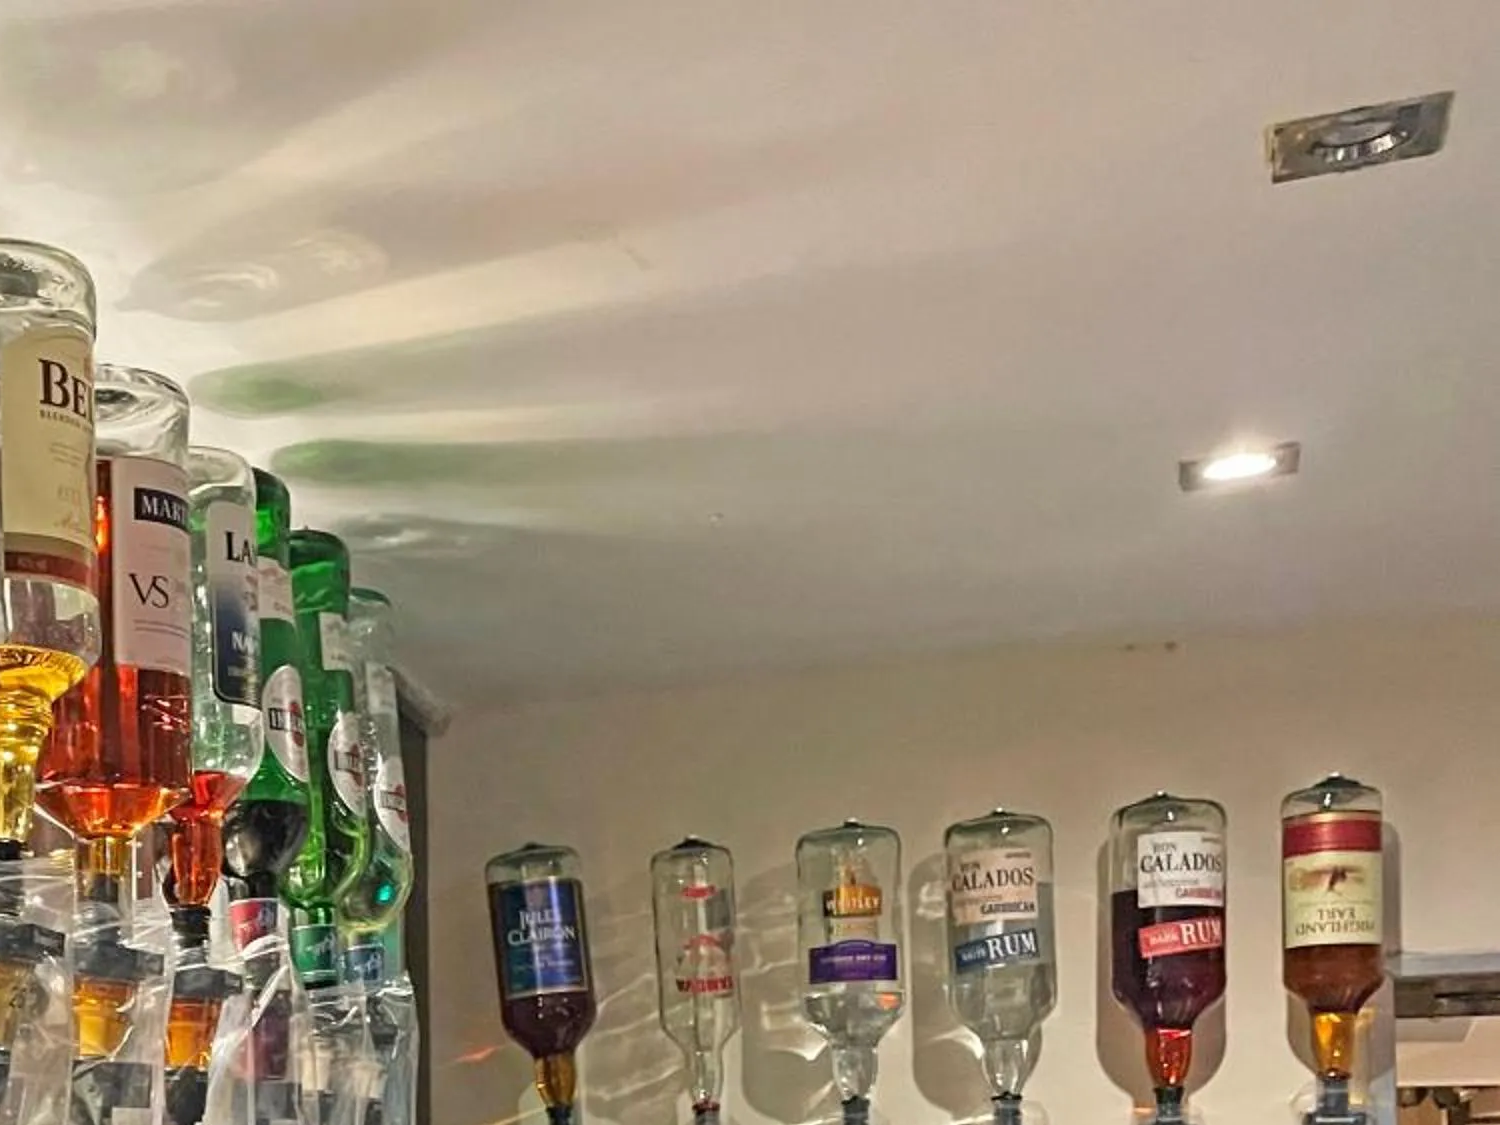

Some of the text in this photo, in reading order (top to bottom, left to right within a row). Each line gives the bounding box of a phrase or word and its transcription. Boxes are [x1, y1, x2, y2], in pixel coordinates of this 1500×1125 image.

[129, 573, 170, 610] VS
[1140, 851, 1223, 874] CALADOS
[952, 865, 1036, 892] CALADOS
[986, 930, 1037, 960] RUM
